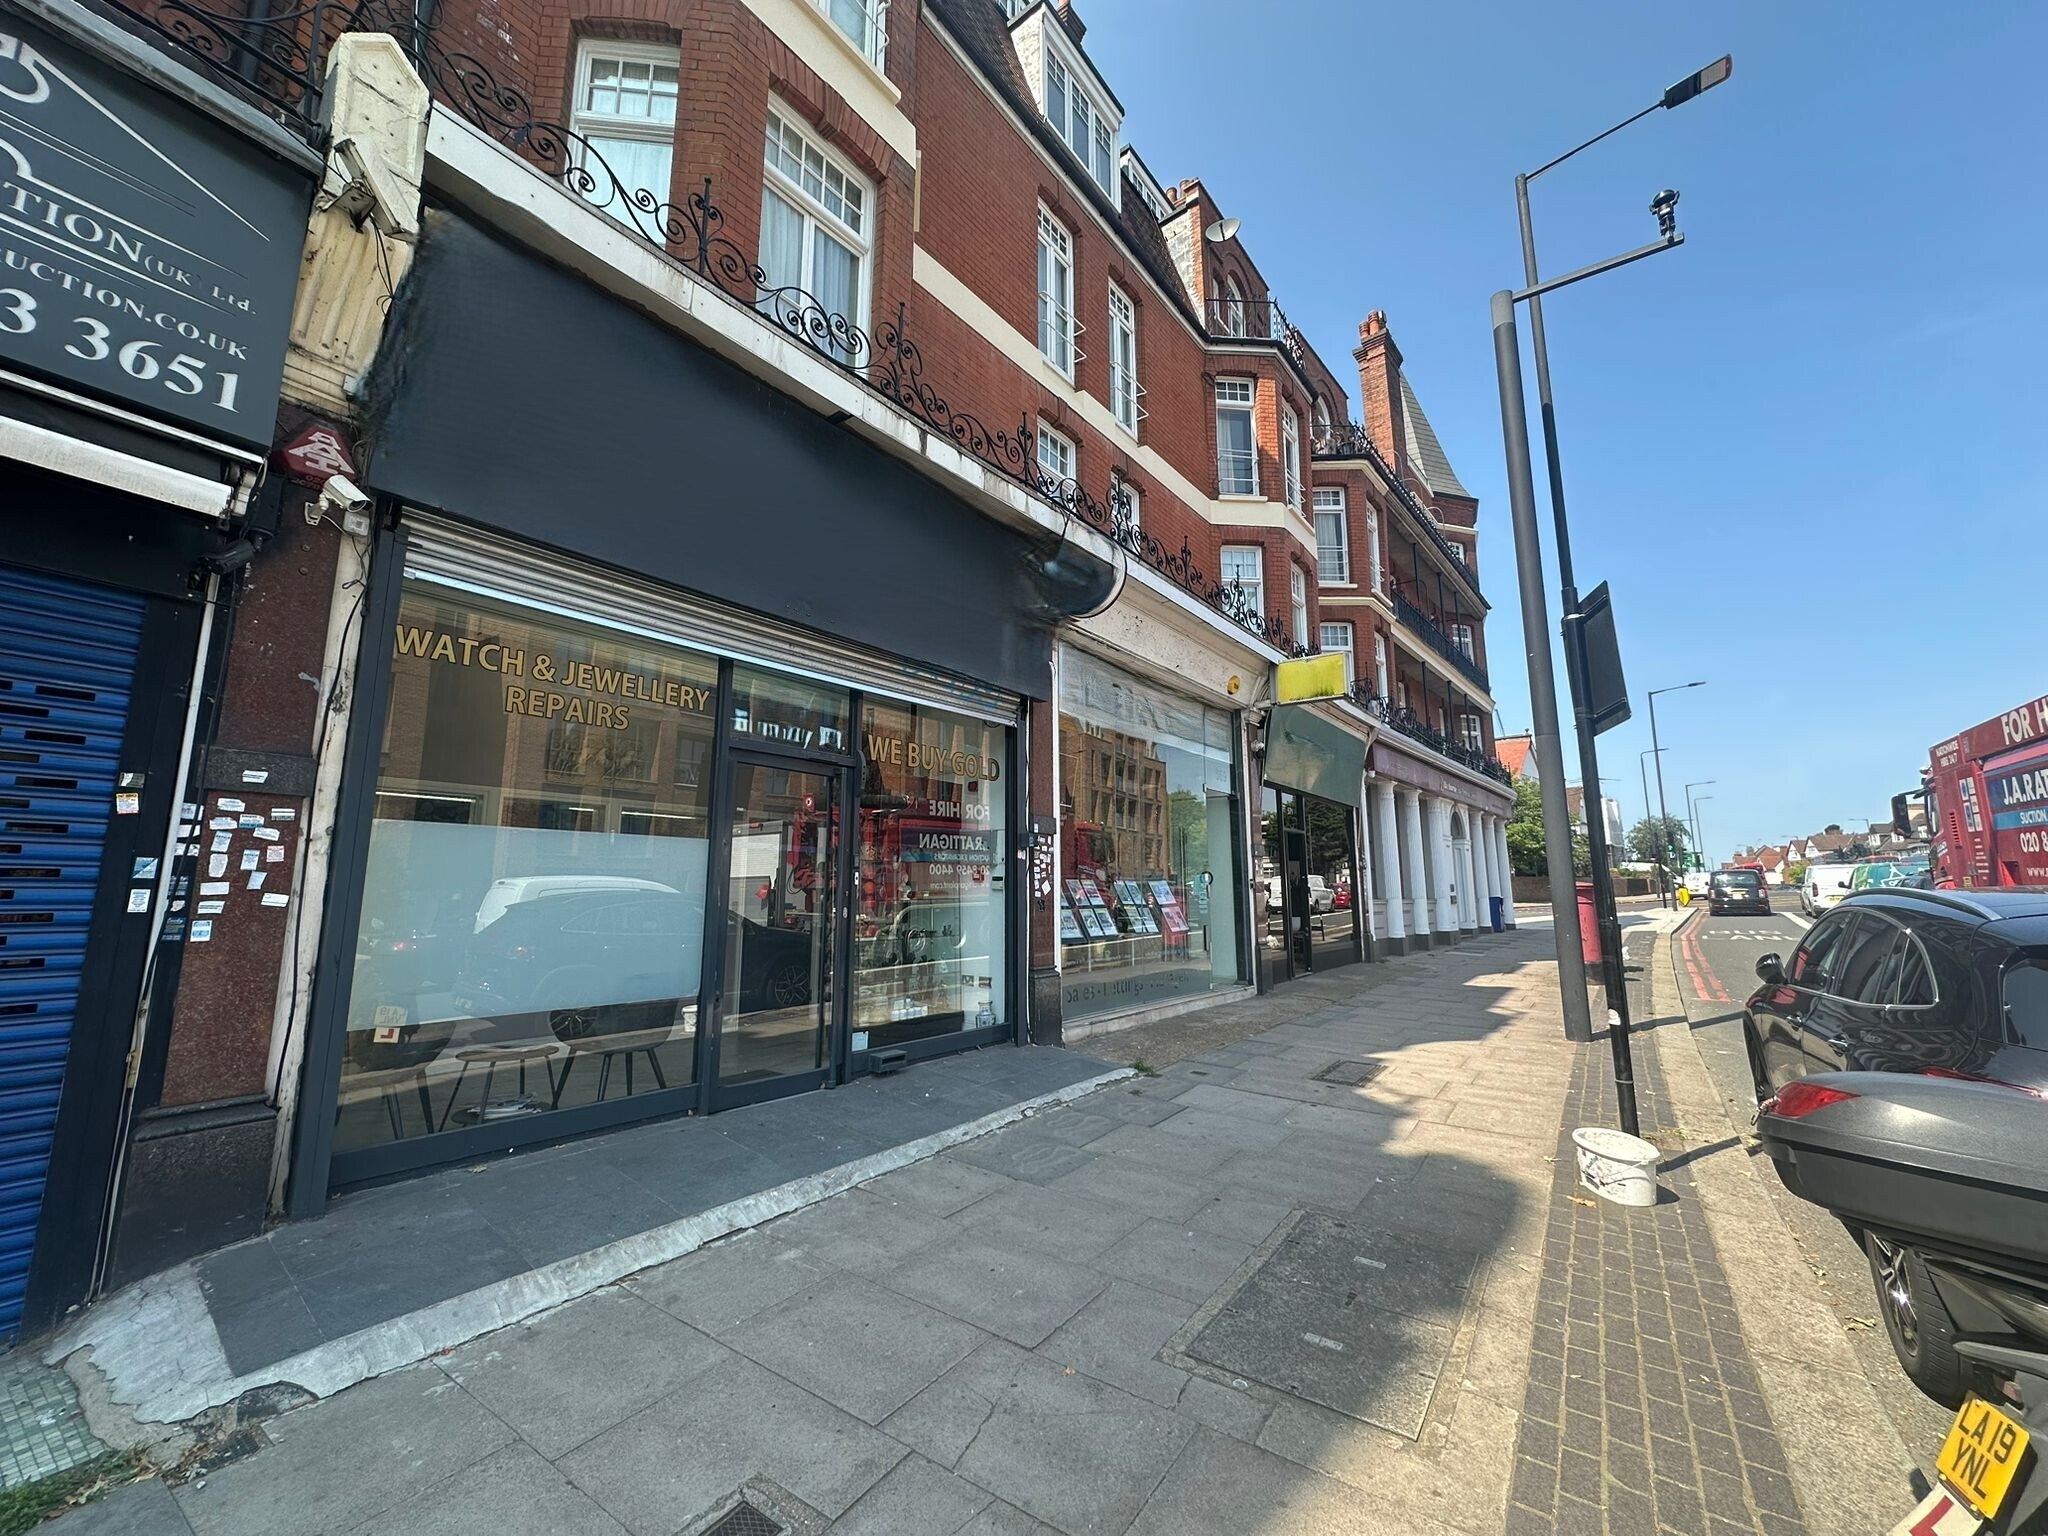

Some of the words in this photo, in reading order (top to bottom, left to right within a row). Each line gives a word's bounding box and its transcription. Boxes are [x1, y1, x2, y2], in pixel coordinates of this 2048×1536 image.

[0, 248, 248, 361] UCTION.CO.UK
[212, 286, 257, 315] Ltd.
[64, 317, 240, 414] 3651
[395, 624, 526, 677] WATCH
[532, 653, 557, 683] &
[561, 660, 711, 712] JEWELLERY
[505, 685, 630, 731] REPAIRS
[2001, 706, 2035, 745] FOR
[2034, 697, 2048, 734] H
[868, 734, 902, 765] WE
[907, 742, 947, 773] BUY
[952, 751, 1000, 782] GOLD
[2020, 831, 2040, 852] 020
[1958, 1400, 2017, 1464] LA19
[1952, 1437, 1990, 1500] YNL
